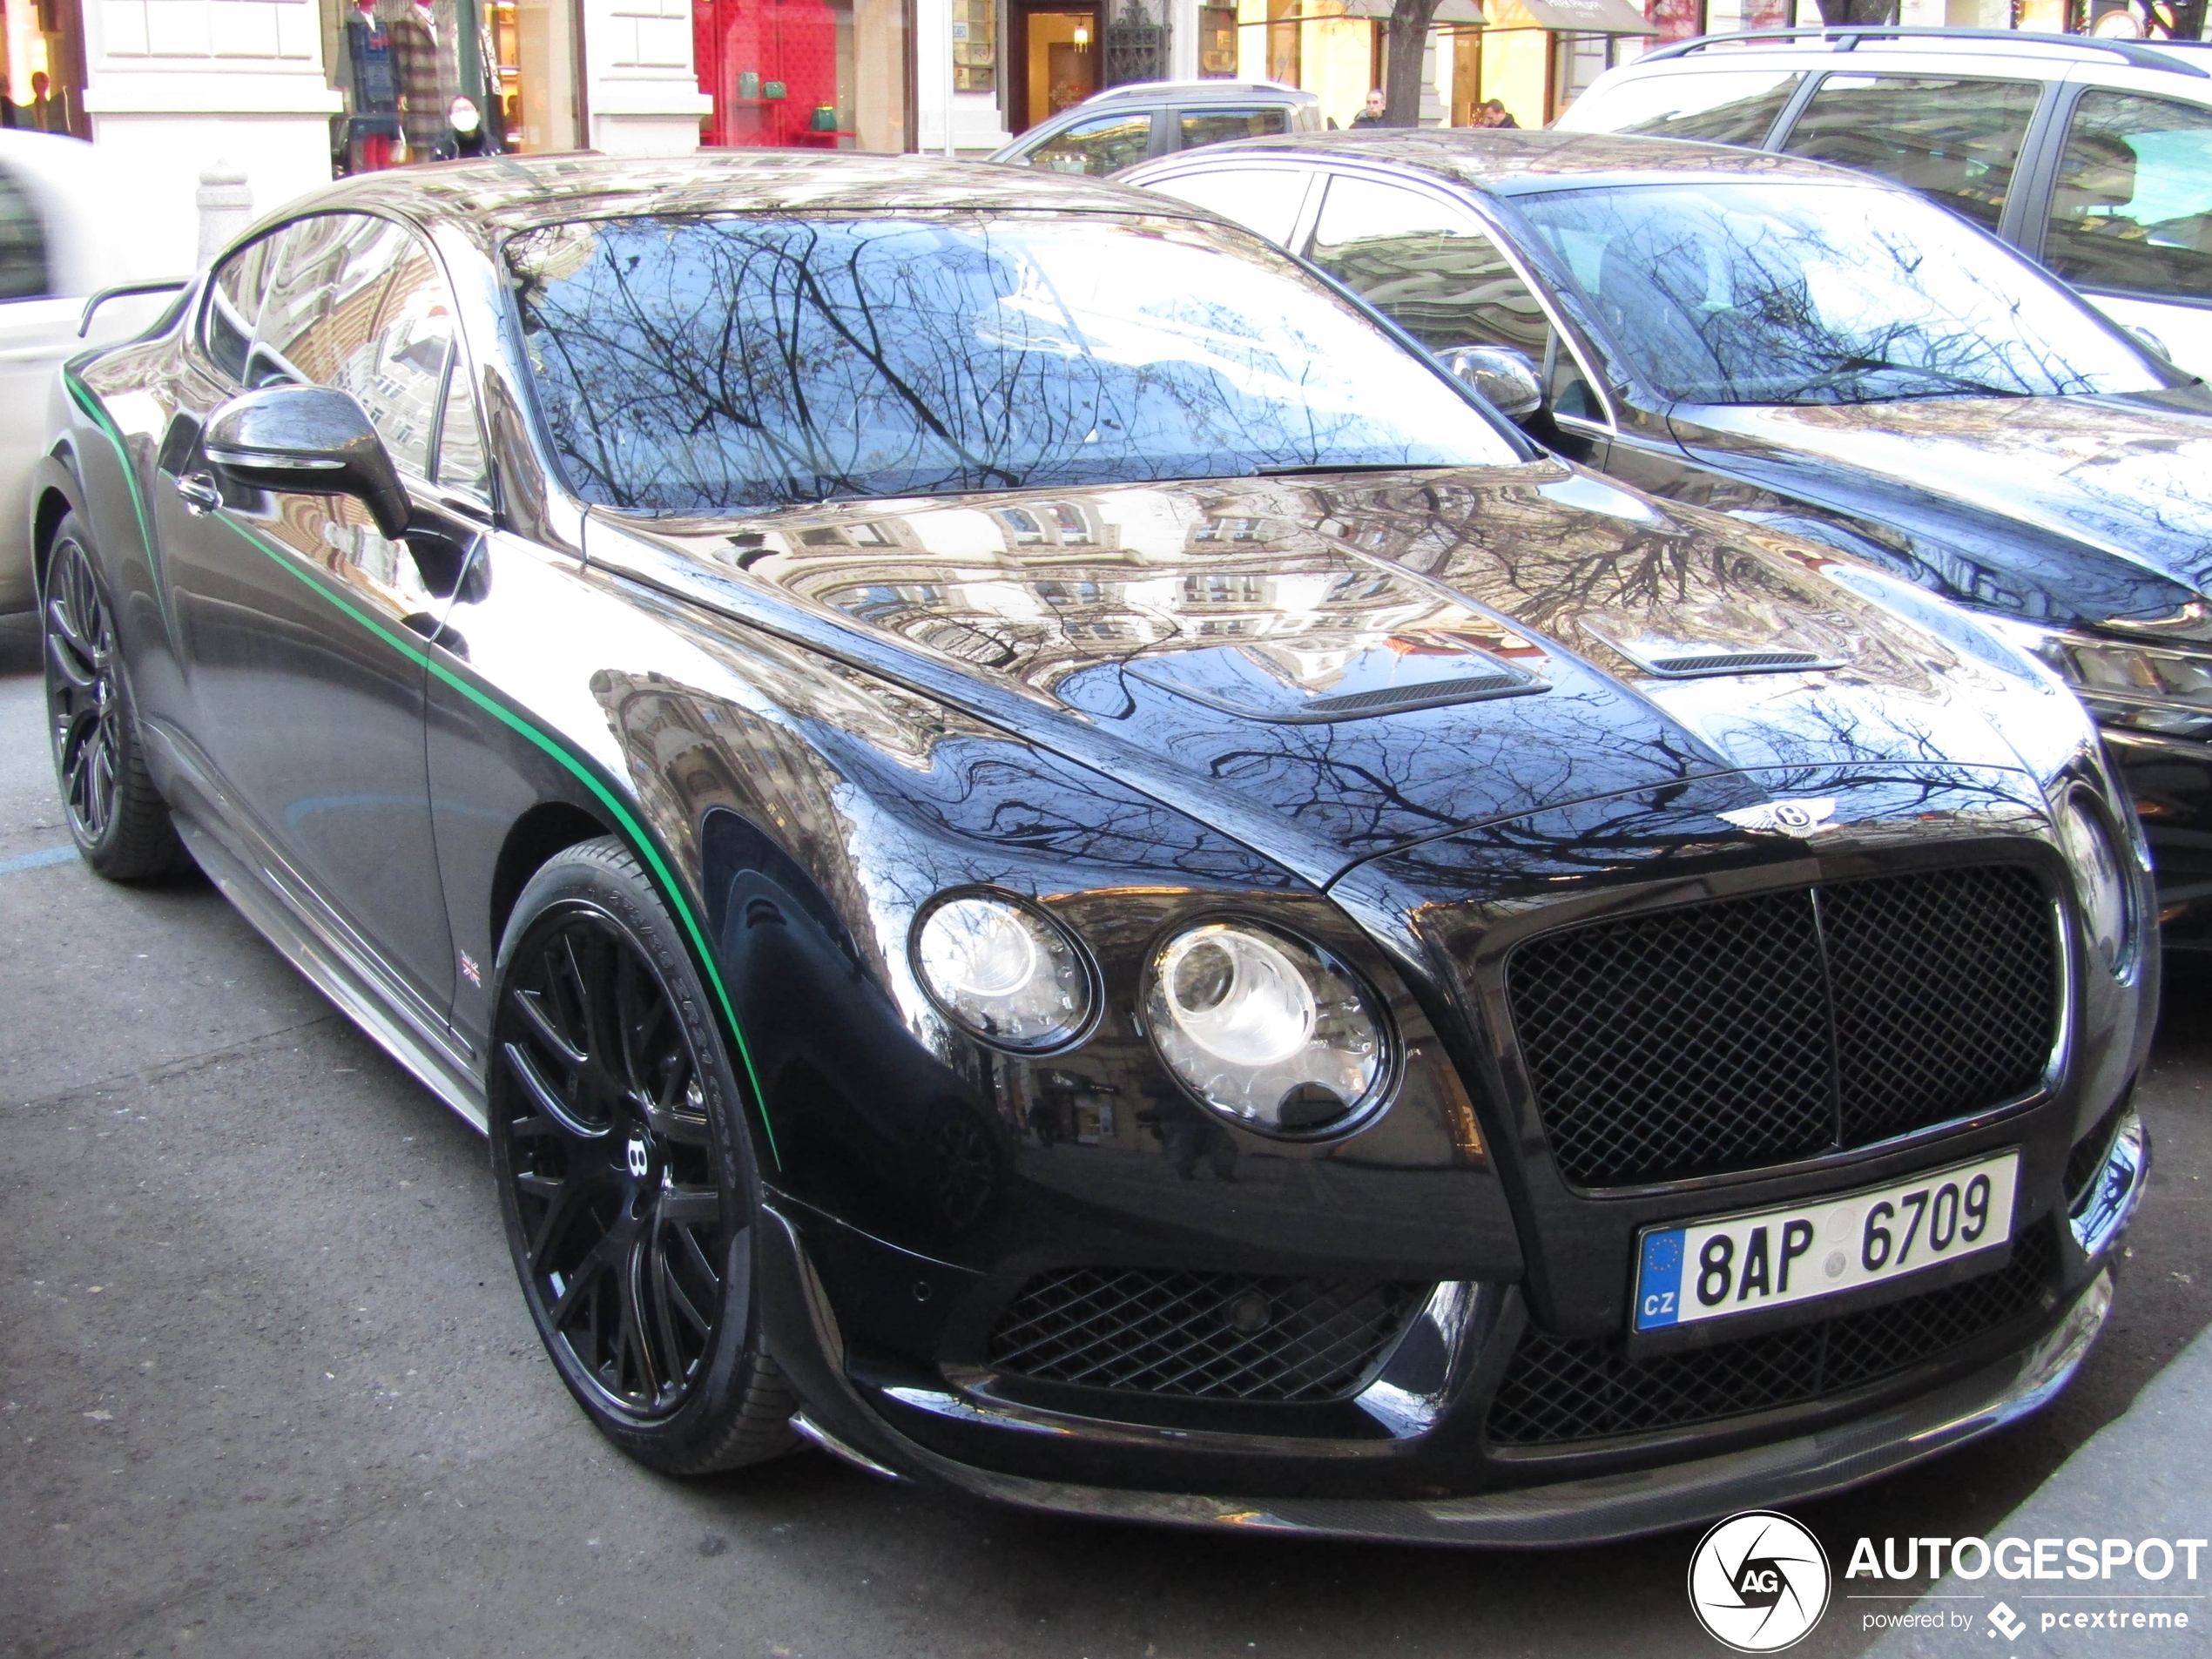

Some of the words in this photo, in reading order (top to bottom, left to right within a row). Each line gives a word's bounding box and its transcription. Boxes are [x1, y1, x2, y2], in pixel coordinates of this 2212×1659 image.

[1696, 1219, 1814, 1306] 8AP
[1861, 1173, 1991, 1271] 6709
[1644, 1291, 1674, 1316] CZ
